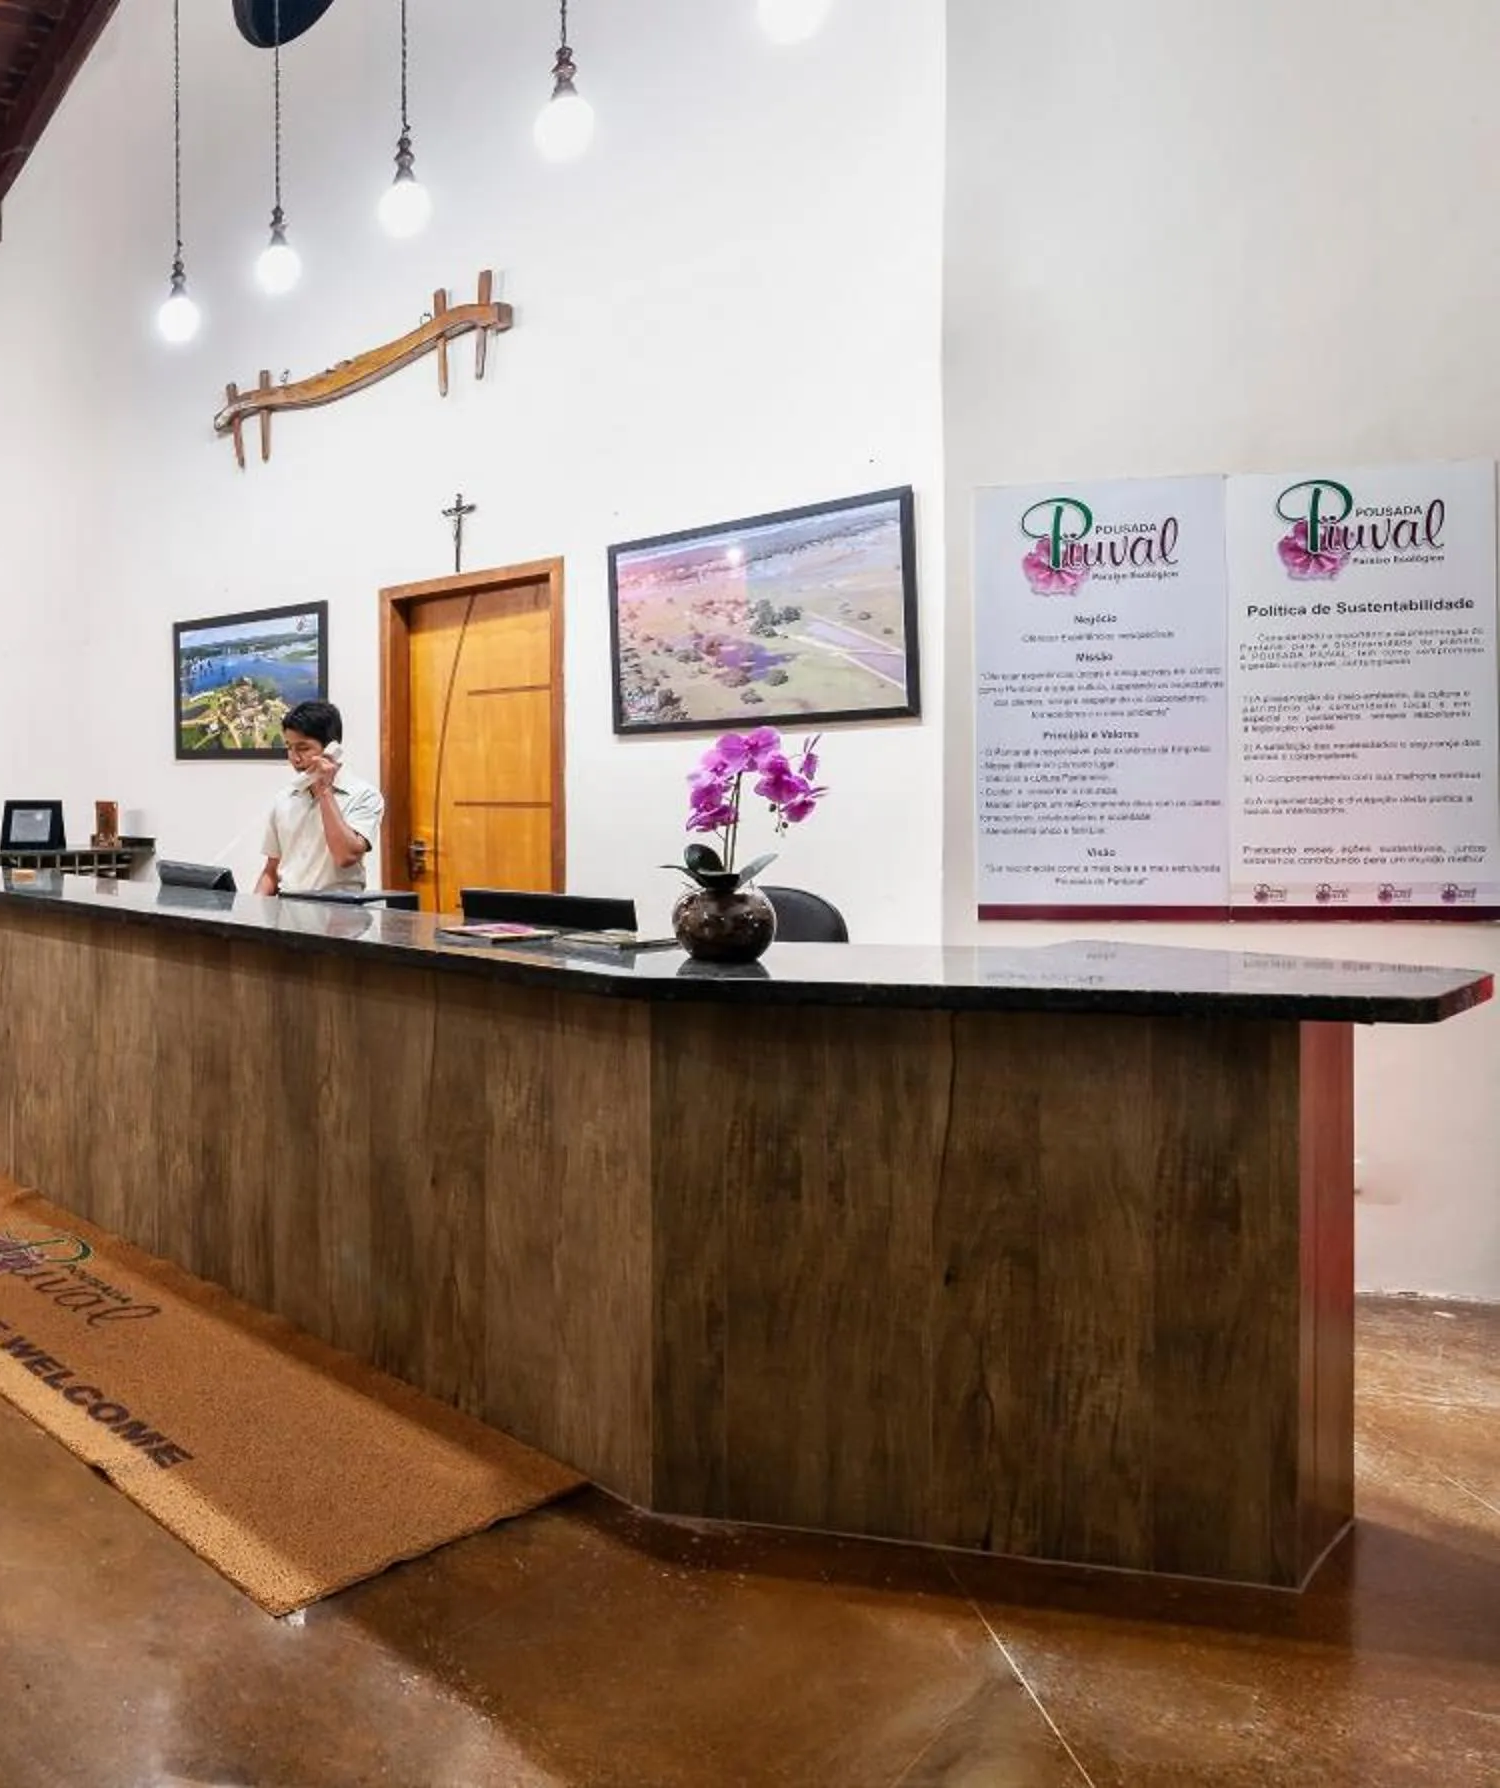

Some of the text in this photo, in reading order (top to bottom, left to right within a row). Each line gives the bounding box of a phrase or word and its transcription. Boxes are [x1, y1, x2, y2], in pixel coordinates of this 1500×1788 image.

[1355, 506, 1423, 517] POUSADA
[1095, 523, 1157, 534] POUSADA
[1311, 602, 1331, 615] de
[1336, 597, 1475, 614] Sustentabilidade
[0, 1335, 195, 1470] WELCOME
